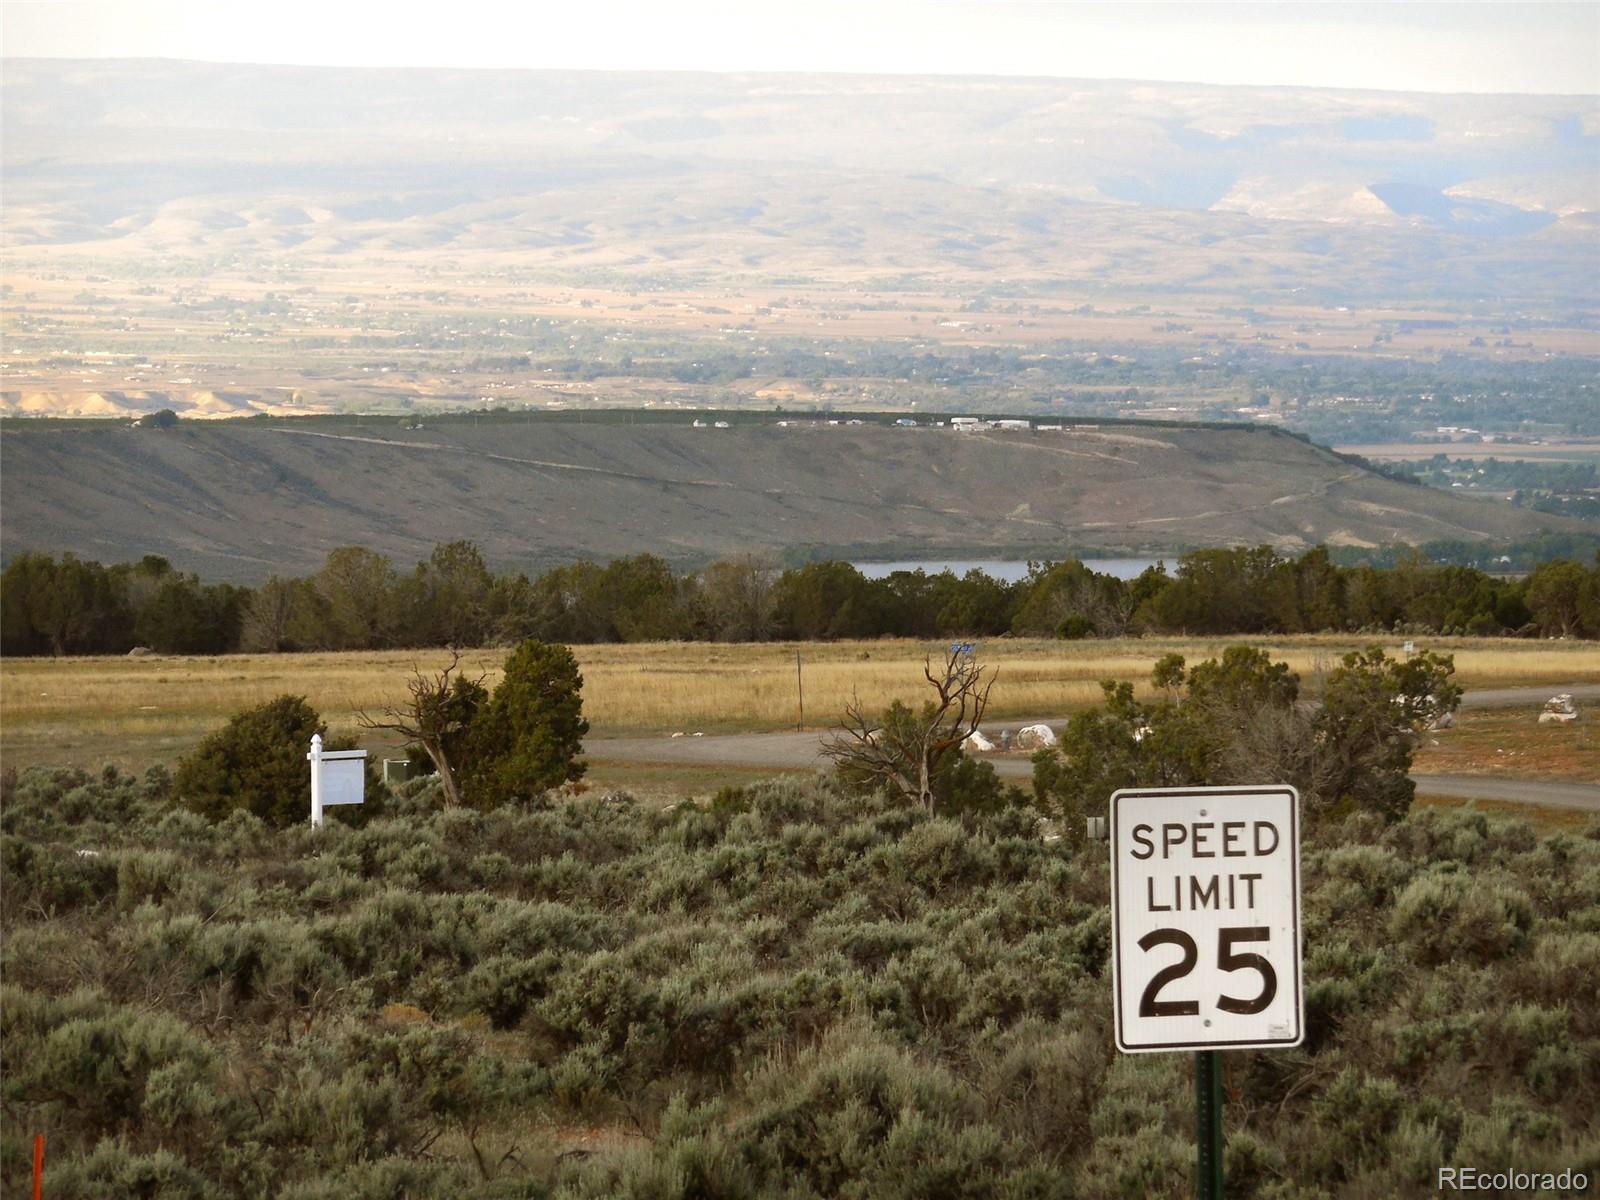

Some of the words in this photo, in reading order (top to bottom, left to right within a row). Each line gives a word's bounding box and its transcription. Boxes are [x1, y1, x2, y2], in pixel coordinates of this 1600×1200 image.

[1130, 821, 1280, 860] SPEED
[1147, 873, 1263, 912] LIMIT
[1137, 926, 1278, 1018] 25
